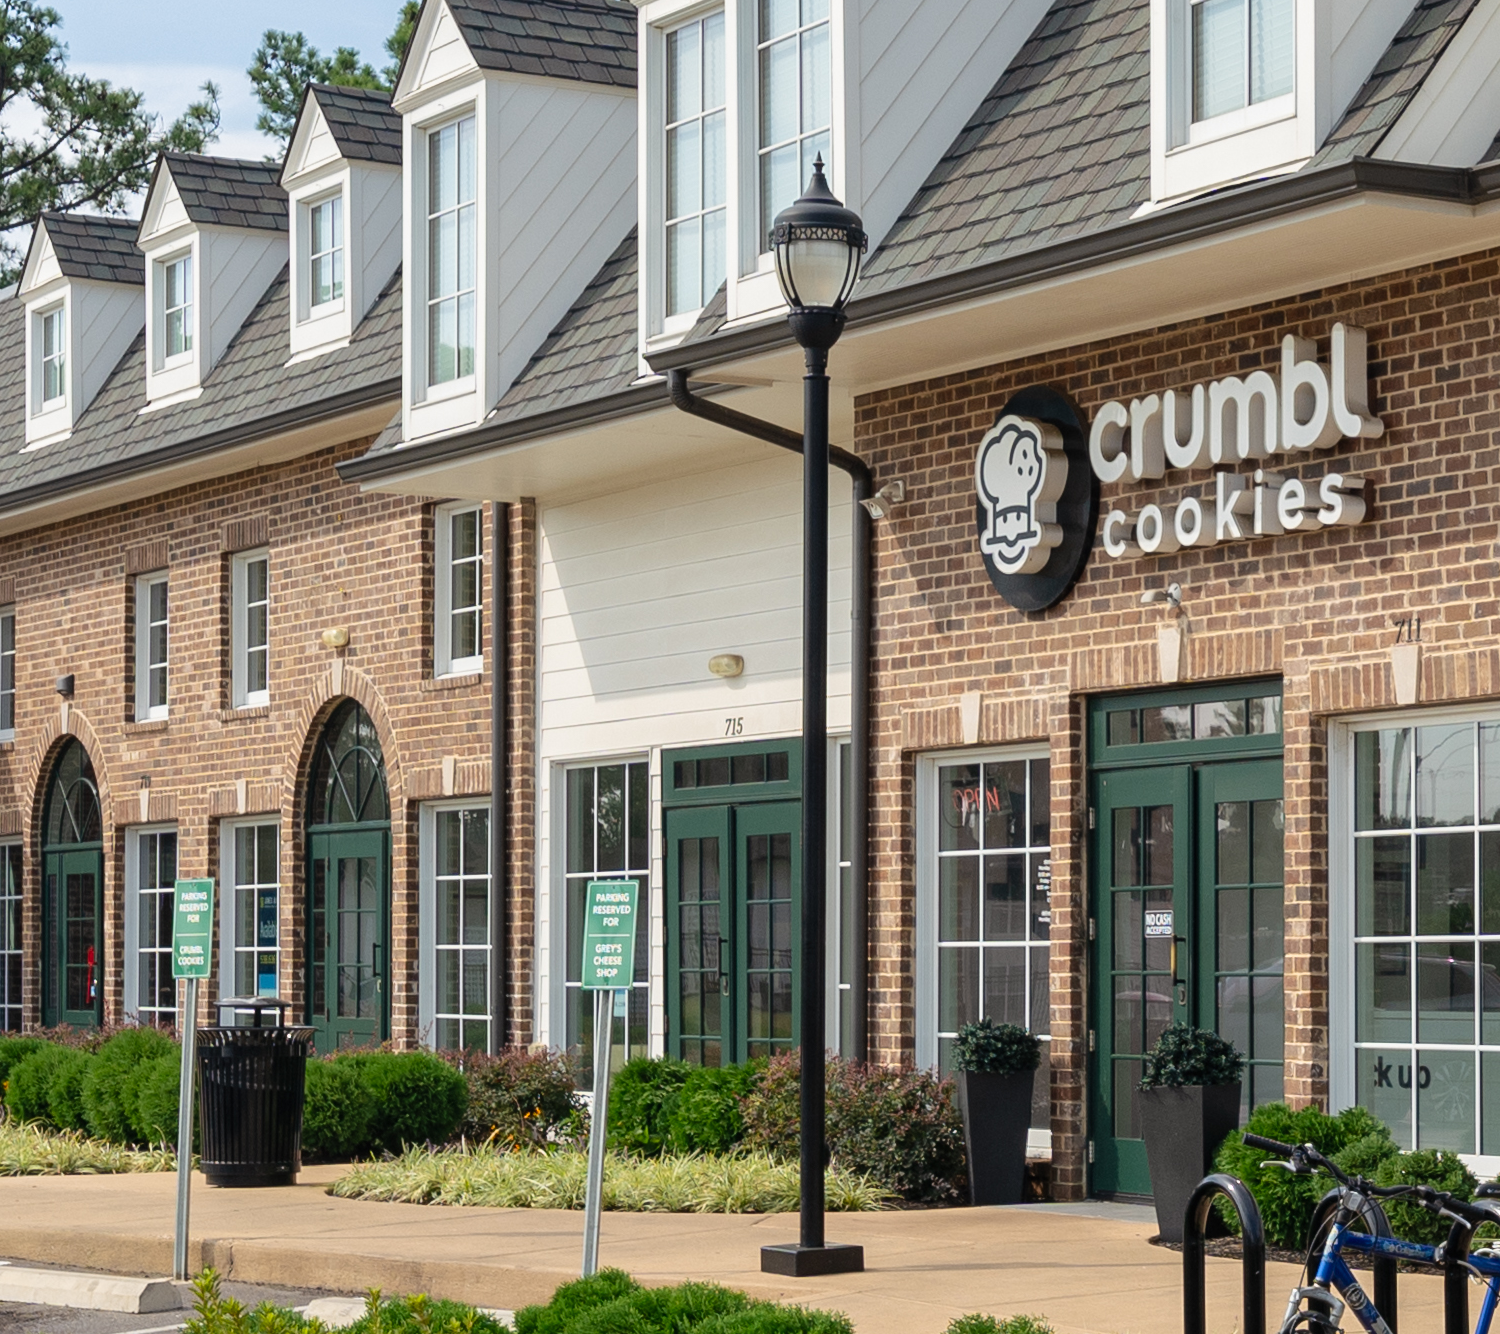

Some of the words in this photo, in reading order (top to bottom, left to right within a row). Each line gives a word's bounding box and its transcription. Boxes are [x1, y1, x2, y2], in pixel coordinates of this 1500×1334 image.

[1089, 322, 1376, 483] crumbl
[1102, 469, 1360, 557] cookies
[1394, 618, 1422, 643] 711
[725, 717, 743, 736] 715
[953, 786, 999, 813] OPEN
[181, 892, 207, 901] PARKING
[596, 893, 629, 902] PARKING
[179, 903, 209, 912] RESERVED
[593, 905, 631, 915] RESERVED
[187, 914, 200, 923] FOR
[603, 918, 620, 927] FOR
[1146, 914, 1156, 926] NO
[1156, 913, 1172, 926] CASH
[595, 944, 622, 953] GREY'S
[178, 957, 204, 966] COOKIES
[594, 956, 622, 966] CHEESE
[596, 969, 618, 978] SHOP
